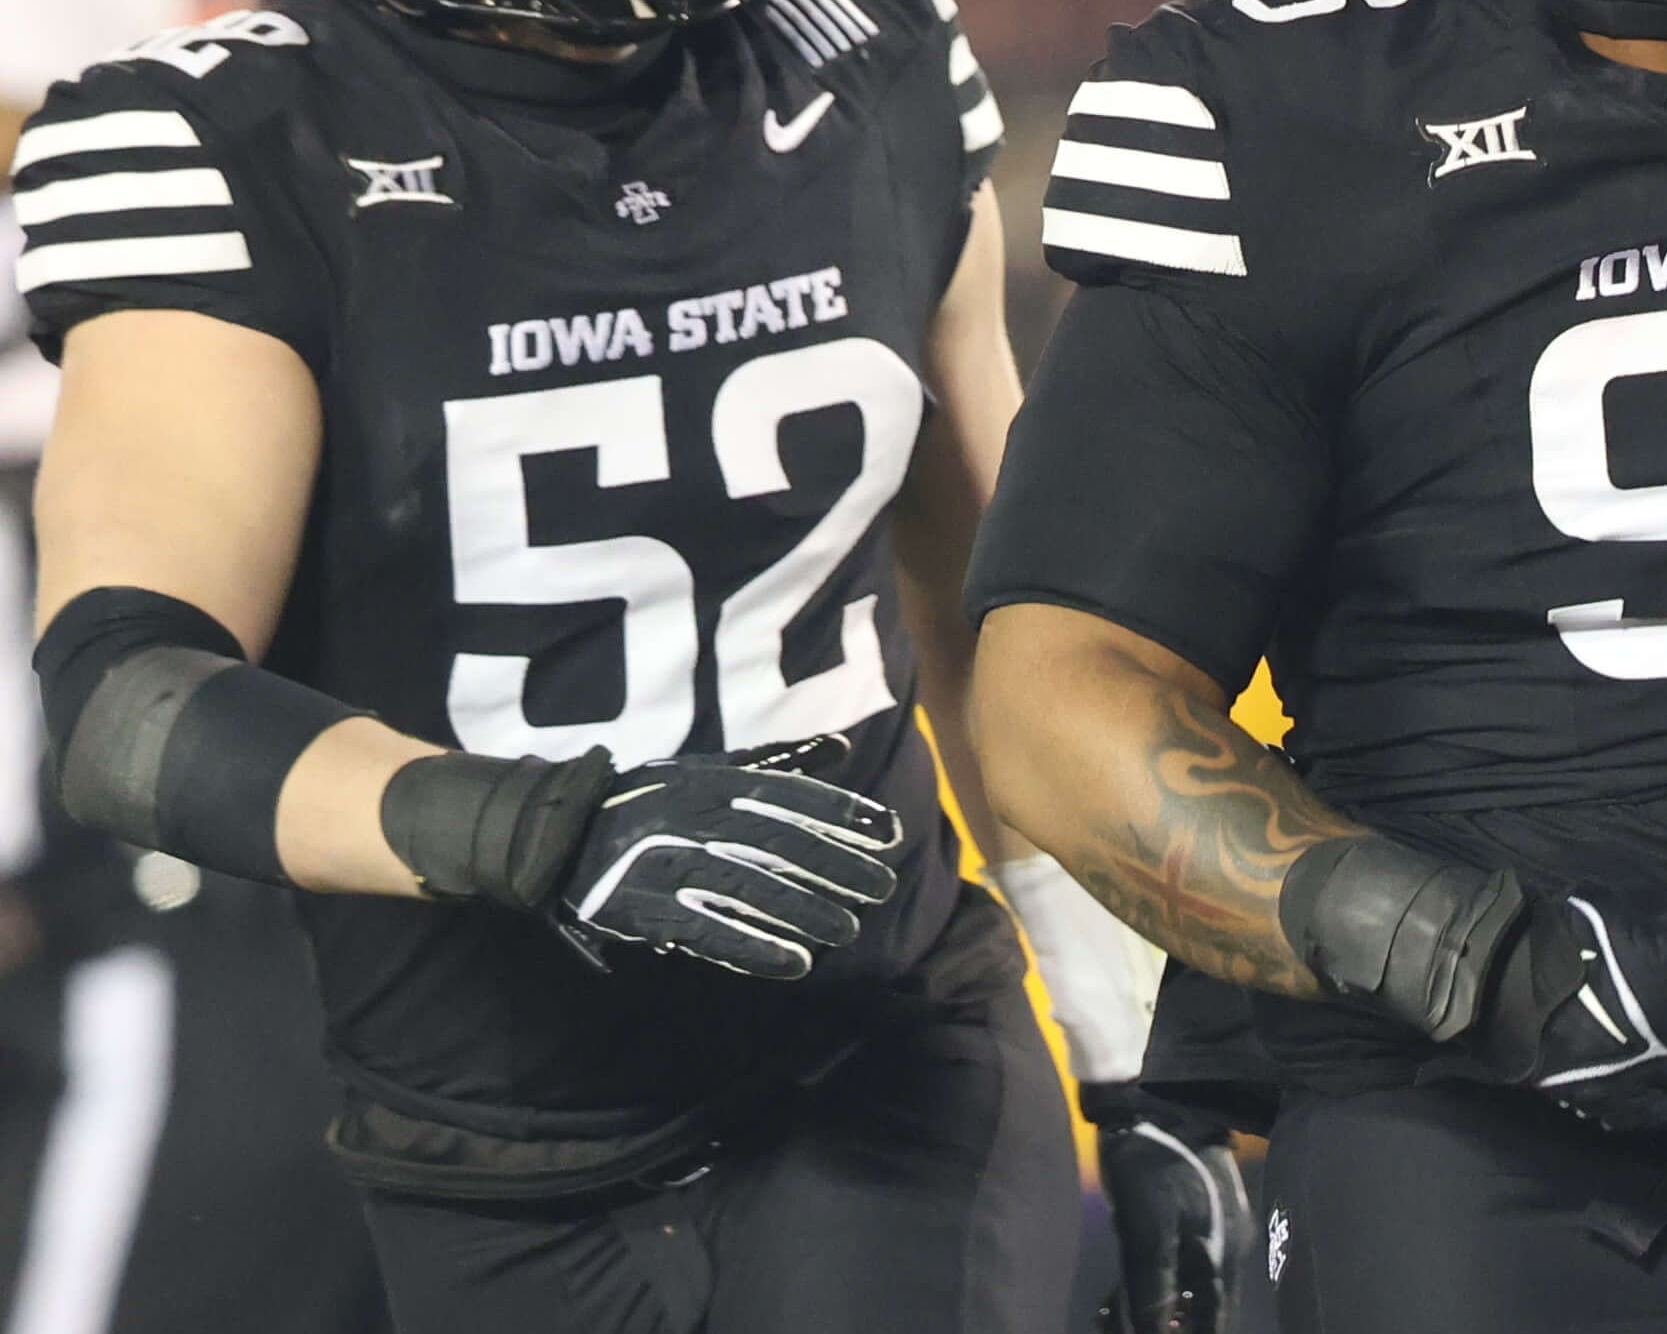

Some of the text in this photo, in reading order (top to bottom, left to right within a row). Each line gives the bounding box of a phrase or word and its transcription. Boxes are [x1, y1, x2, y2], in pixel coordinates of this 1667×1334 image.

[487, 266, 849, 376] IOWA STATE
[443, 336, 925, 772] 52
